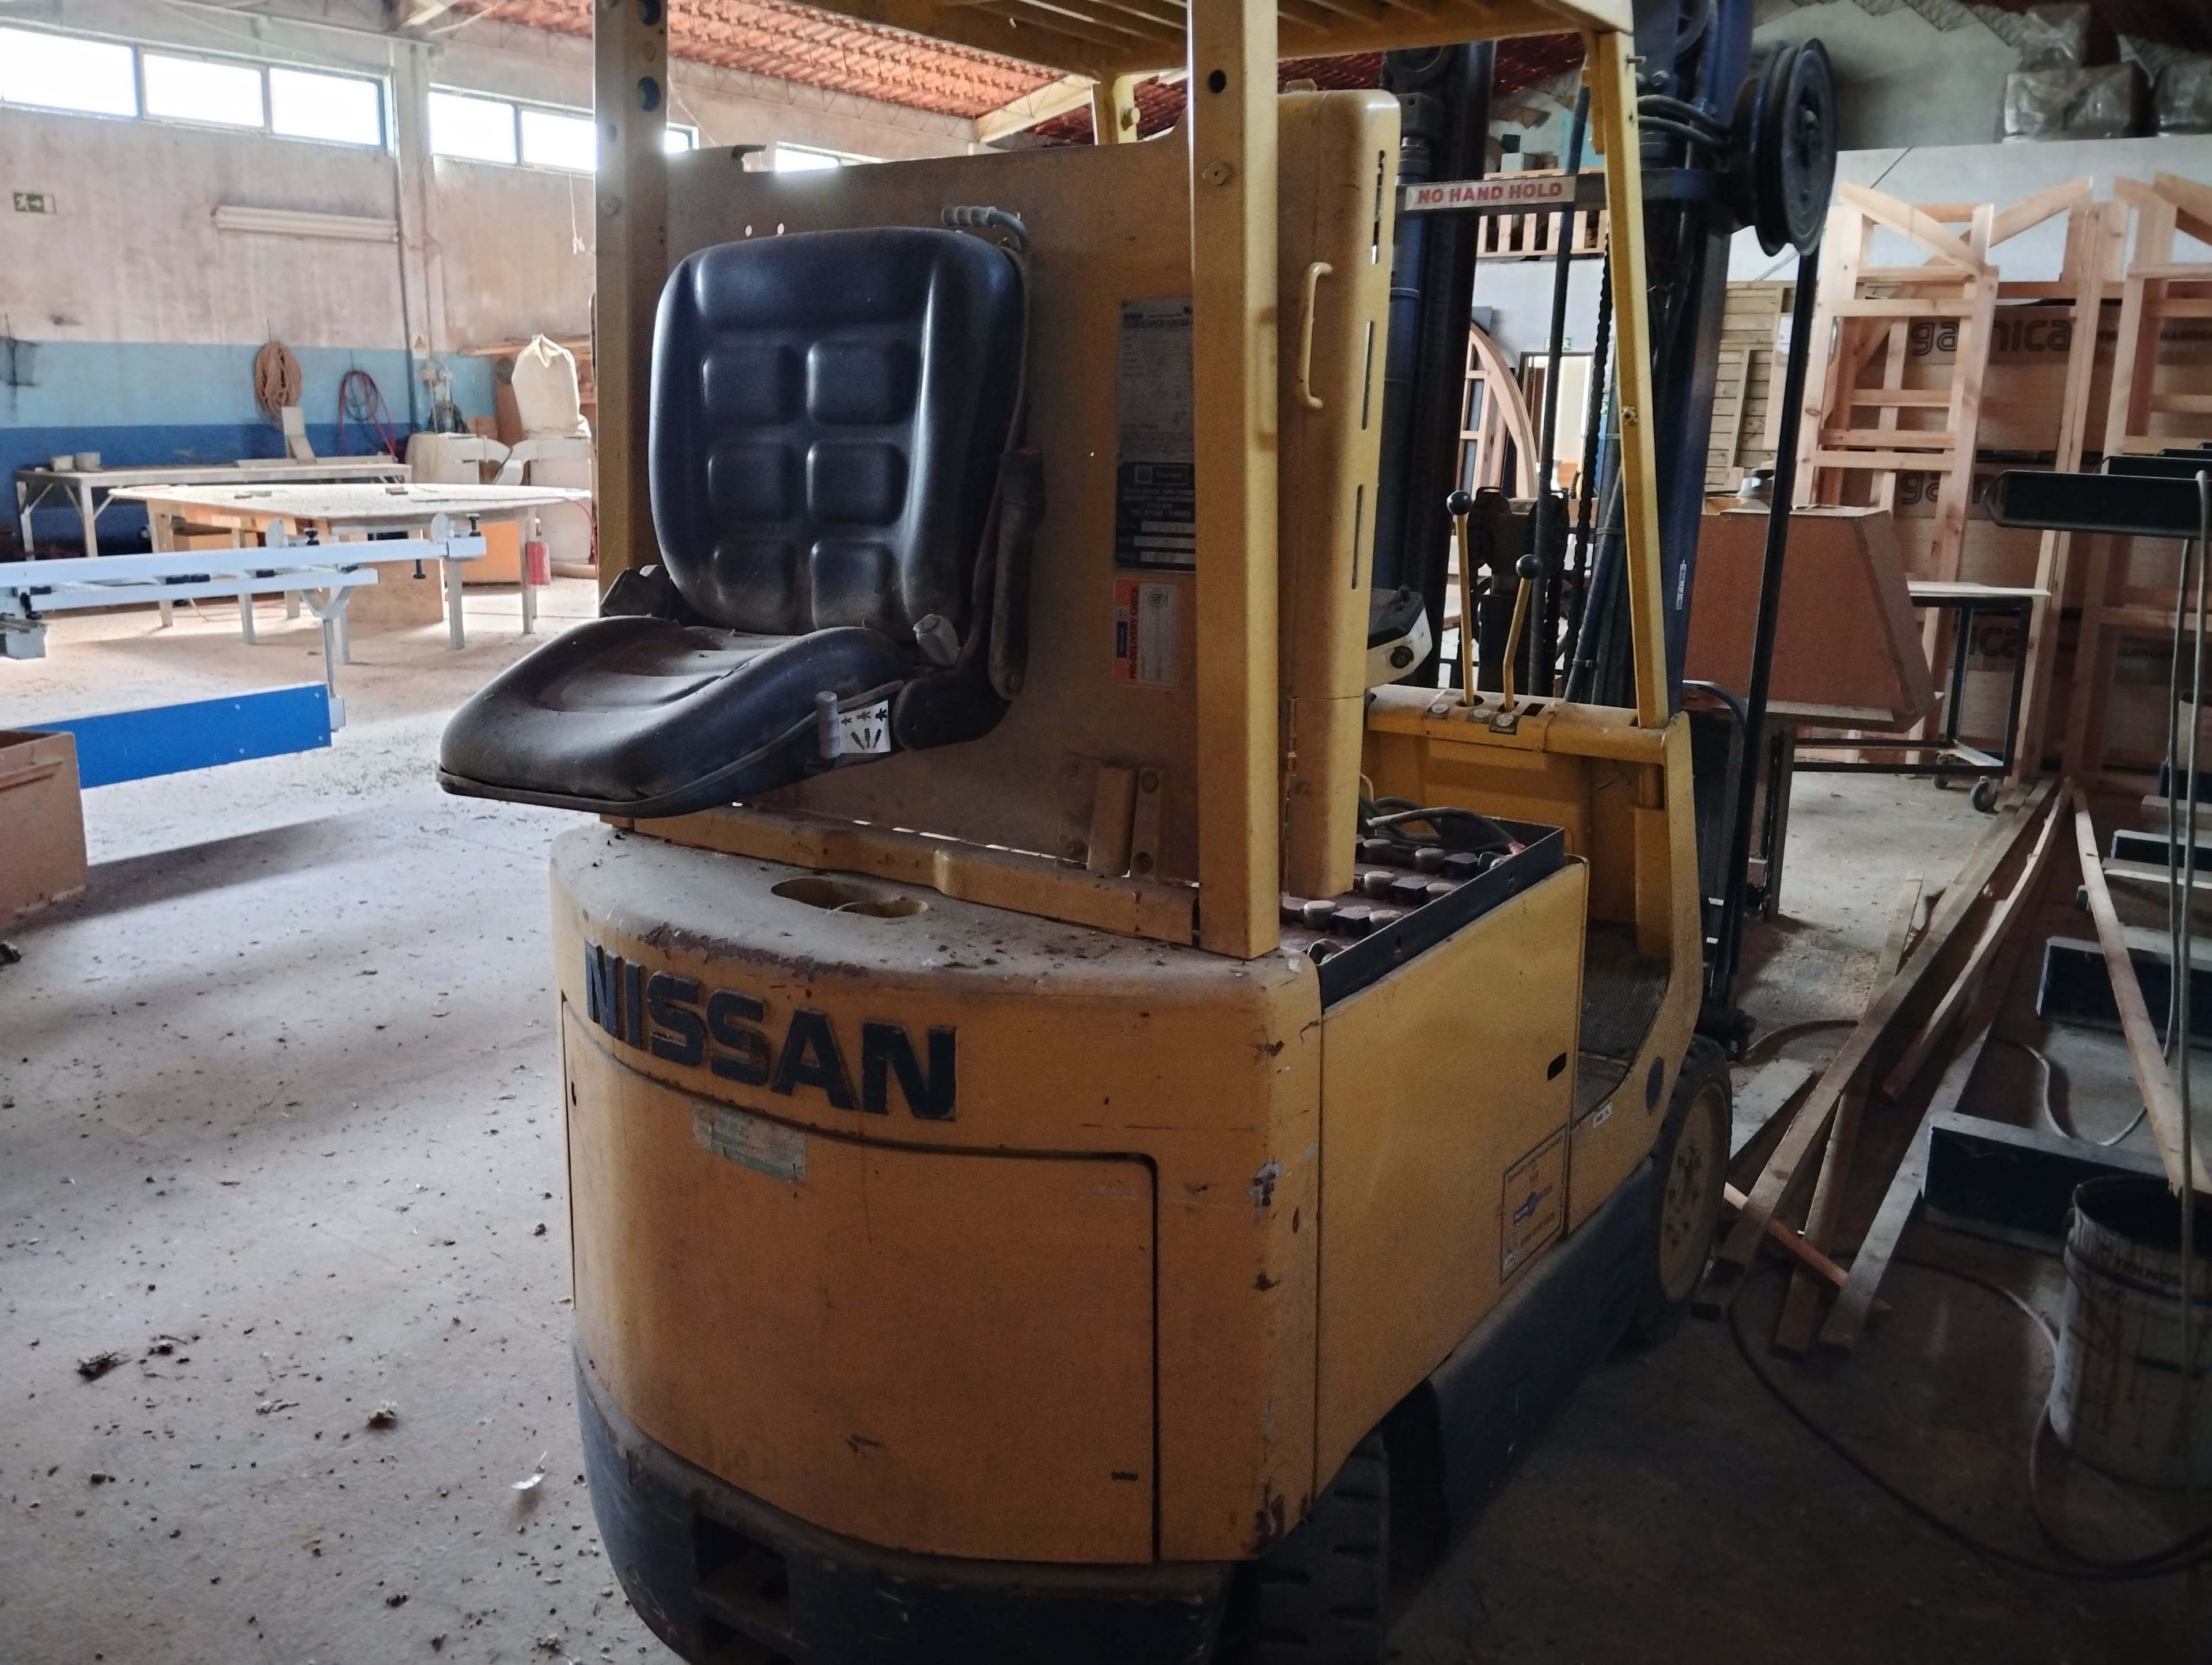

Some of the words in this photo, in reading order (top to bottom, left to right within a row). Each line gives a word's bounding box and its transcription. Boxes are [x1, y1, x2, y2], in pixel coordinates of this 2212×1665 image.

[1418, 188, 1444, 203] NO
[1449, 186, 1503, 202] HAND
[1509, 182, 1563, 199] HOLD
[1910, 320, 2072, 356] ganica
[1130, 586, 1139, 616] CHECK
[585, 937, 957, 1121] NISSAN
